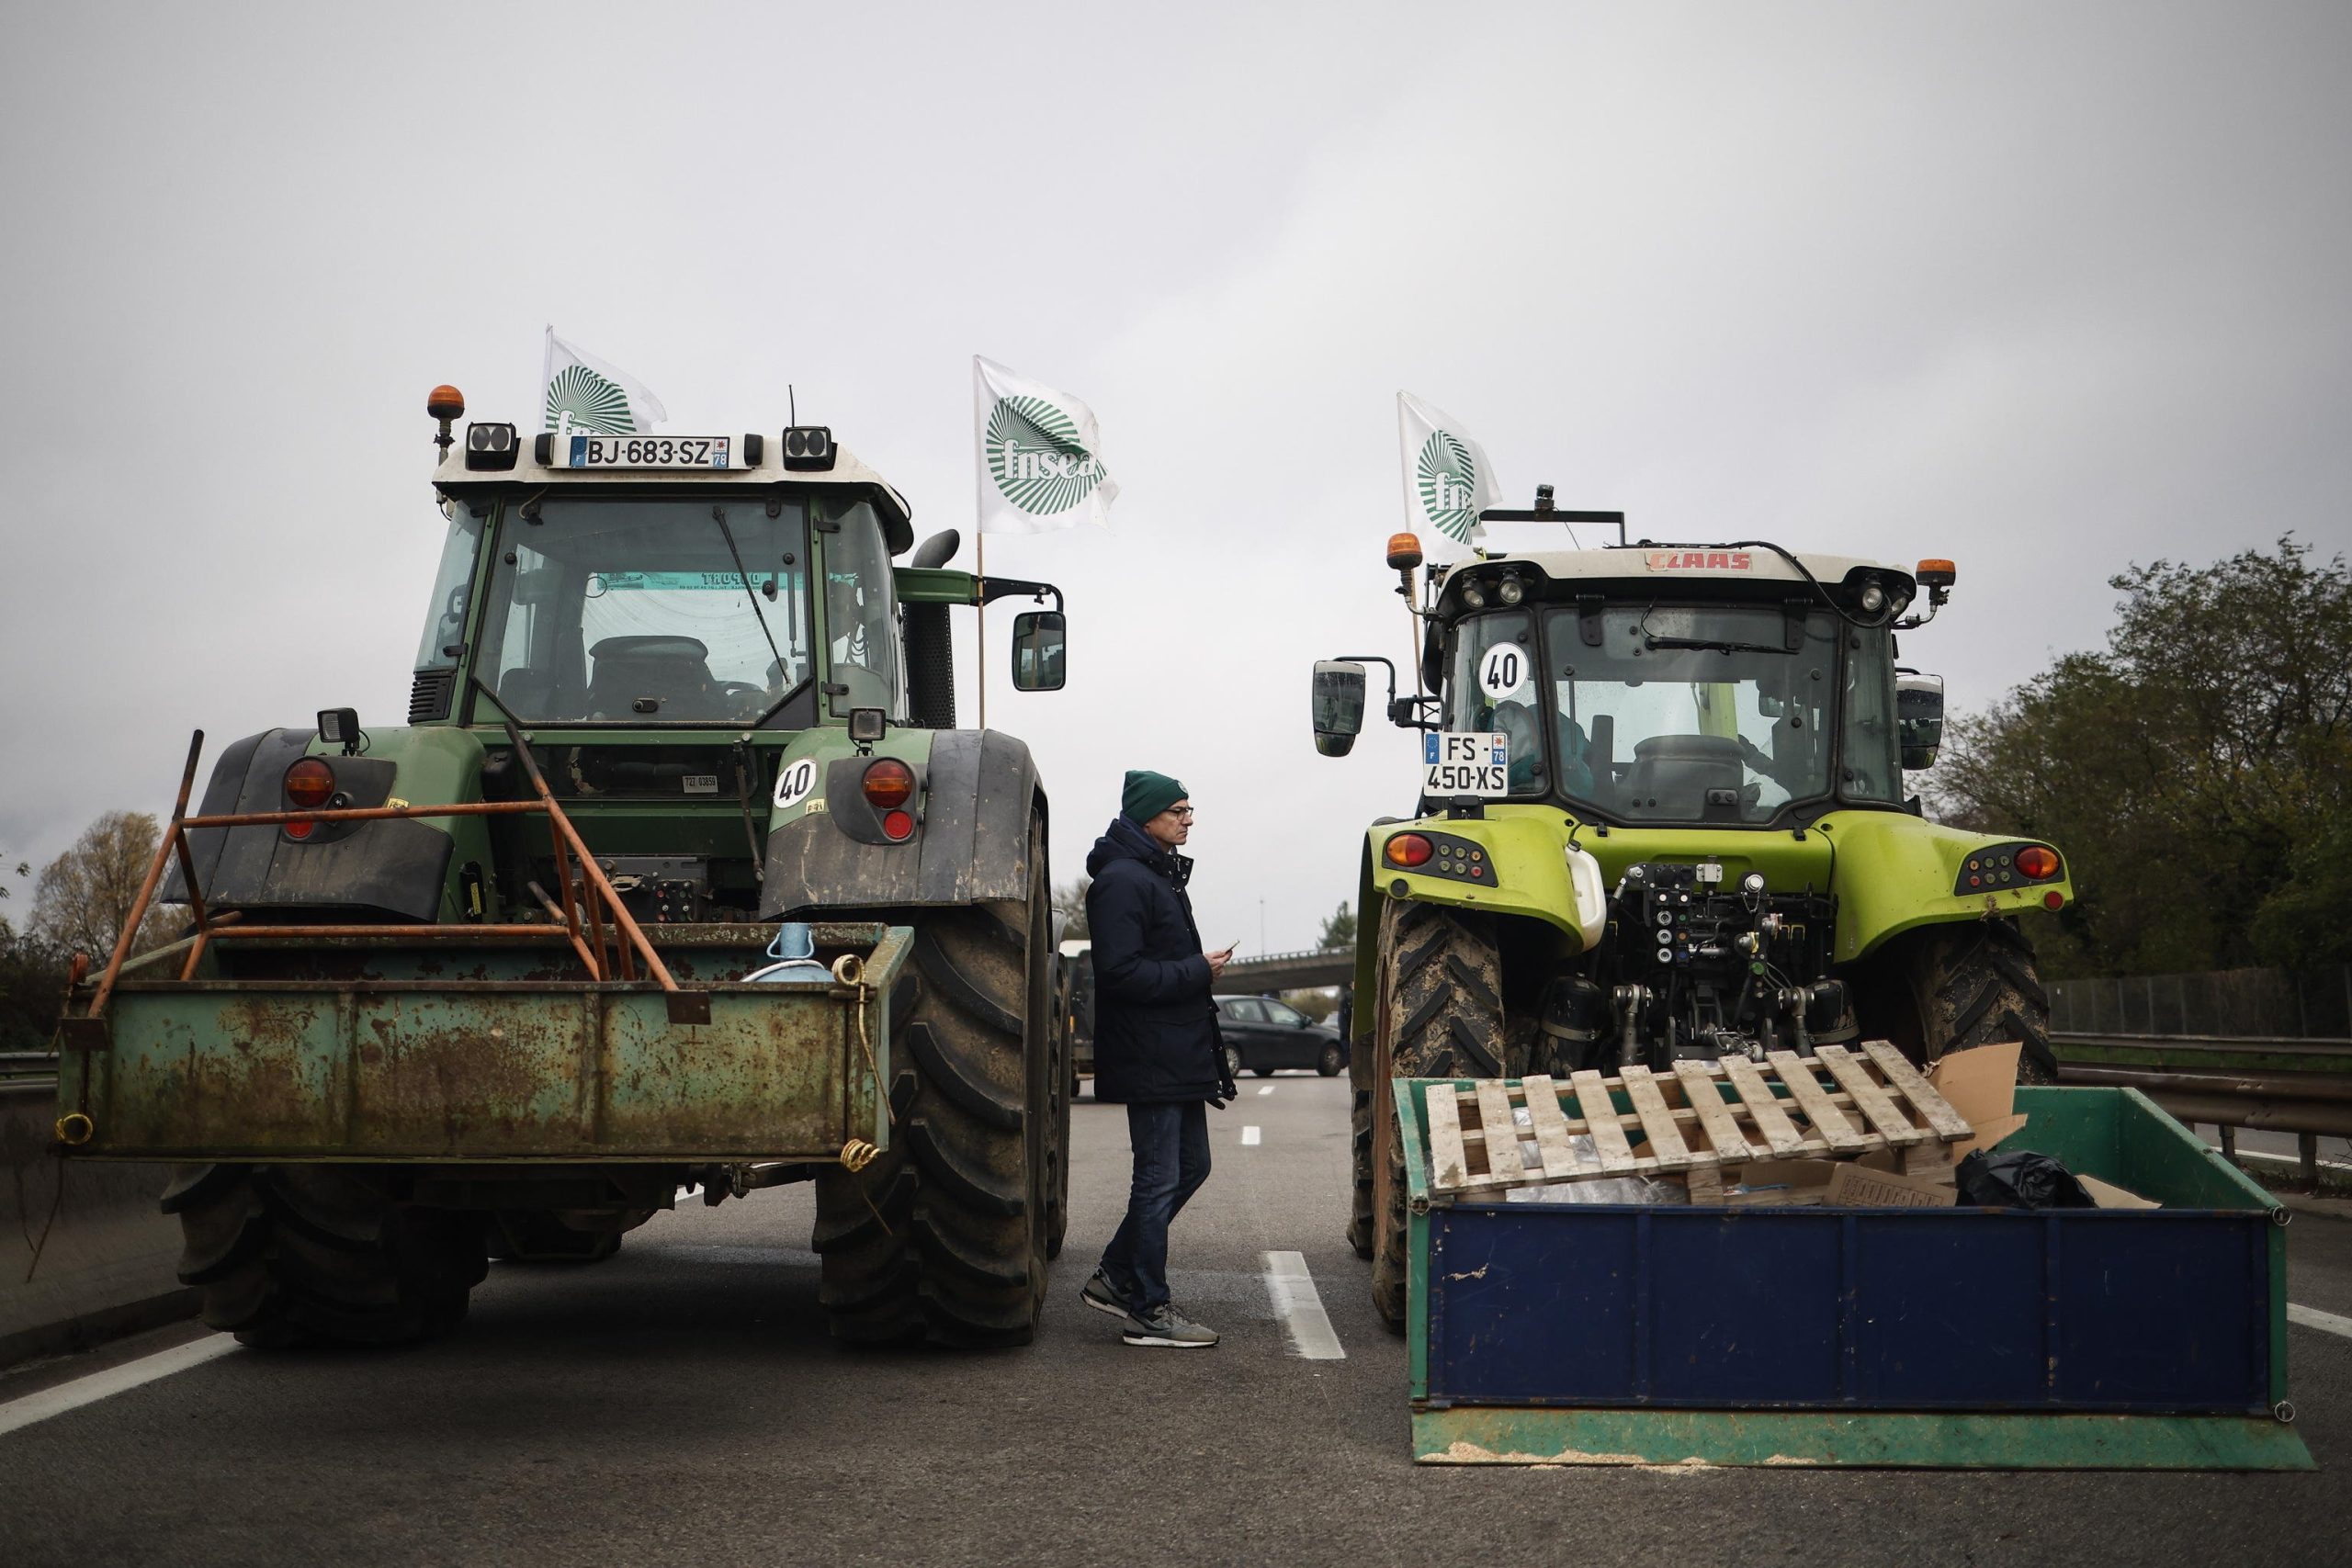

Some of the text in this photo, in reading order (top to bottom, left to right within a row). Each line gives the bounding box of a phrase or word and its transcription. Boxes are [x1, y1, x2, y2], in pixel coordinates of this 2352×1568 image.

[588, 440, 710, 465] BJ-683-SZ
[714, 454, 727, 466] 78
[1001, 439, 1097, 480] fnsea
[1649, 552, 1750, 570] CLAAS
[1487, 653, 1518, 689] 40
[1493, 750, 1505, 761] 78
[779, 763, 810, 801] 40
[1428, 766, 1504, 790] 450-XS
